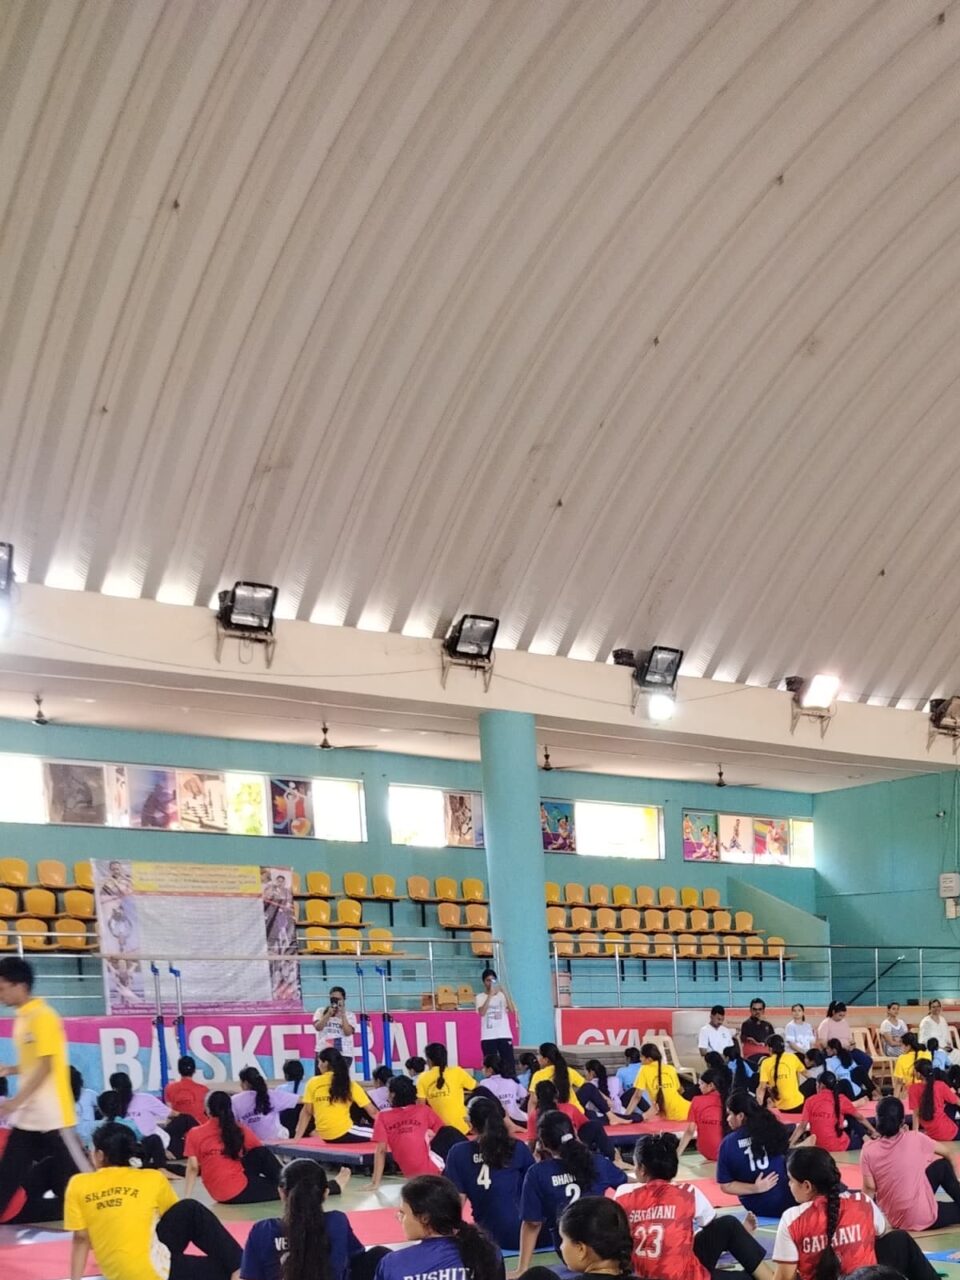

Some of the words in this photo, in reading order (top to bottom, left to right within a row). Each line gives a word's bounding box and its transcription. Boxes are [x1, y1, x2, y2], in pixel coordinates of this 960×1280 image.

[577, 1028, 668, 1046] GYM
[99, 1020, 474, 1091] BASKEBALL
[477, 1164, 492, 1190] 4
[634, 1223, 664, 1259] 23
